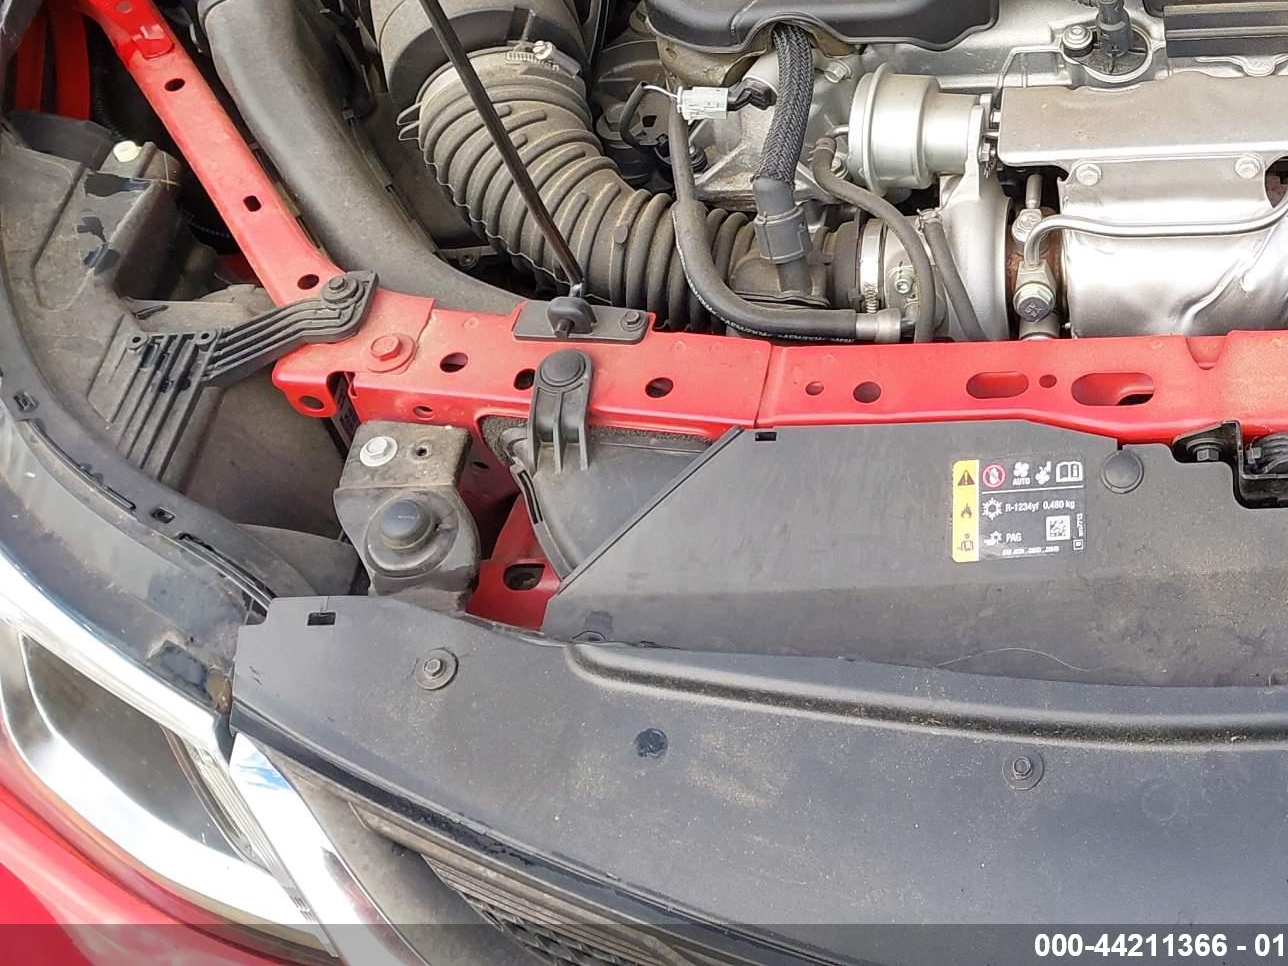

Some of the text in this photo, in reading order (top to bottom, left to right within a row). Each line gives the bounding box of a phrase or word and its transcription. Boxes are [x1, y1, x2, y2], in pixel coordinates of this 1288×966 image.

[1012, 477, 1031, 486] AUTO
[1005, 501, 1040, 513] R-1234yf
[1065, 499, 1076, 510] kg
[1005, 532, 1022, 542] PAG
